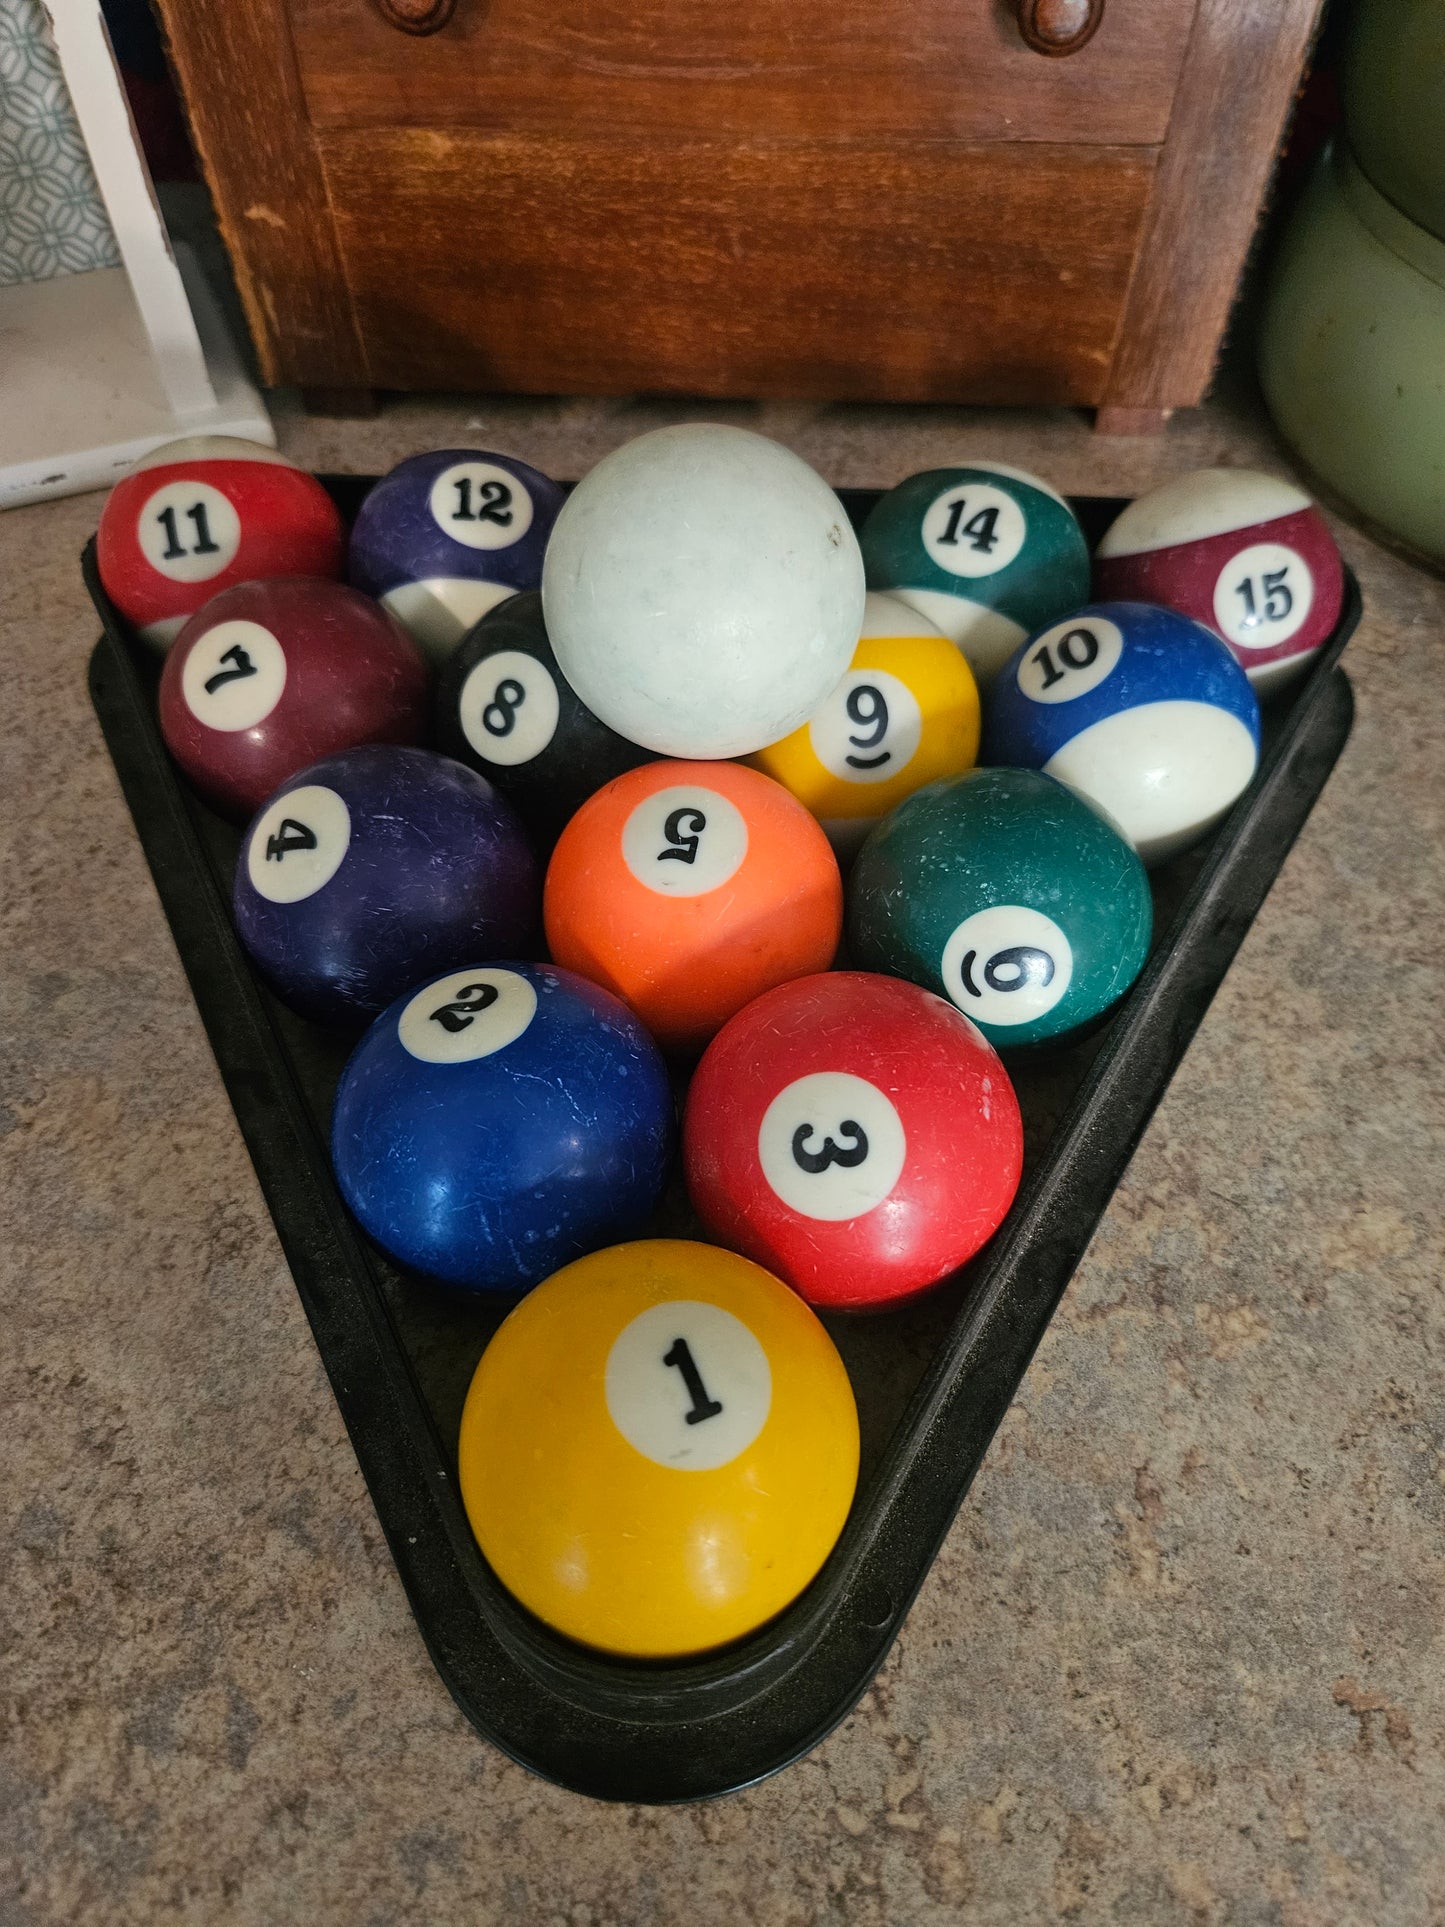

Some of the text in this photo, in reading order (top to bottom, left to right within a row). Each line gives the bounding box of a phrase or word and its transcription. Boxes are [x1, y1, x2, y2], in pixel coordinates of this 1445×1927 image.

[157, 501, 220, 559] 11
[452, 478, 513, 527] 12
[936, 499, 1000, 555] 14
[1236, 567, 1293, 629] 15
[204, 645, 257, 694] 7
[1031, 627, 1099, 690] 10
[483, 679, 525, 737] 8
[846, 685, 889, 748] 9
[266, 817, 317, 862] 4
[657, 808, 706, 864] 5
[984, 946, 1055, 993] 6
[429, 982, 498, 1032] 2
[792, 1120, 868, 1173] 3
[663, 1338, 722, 1425] 1
